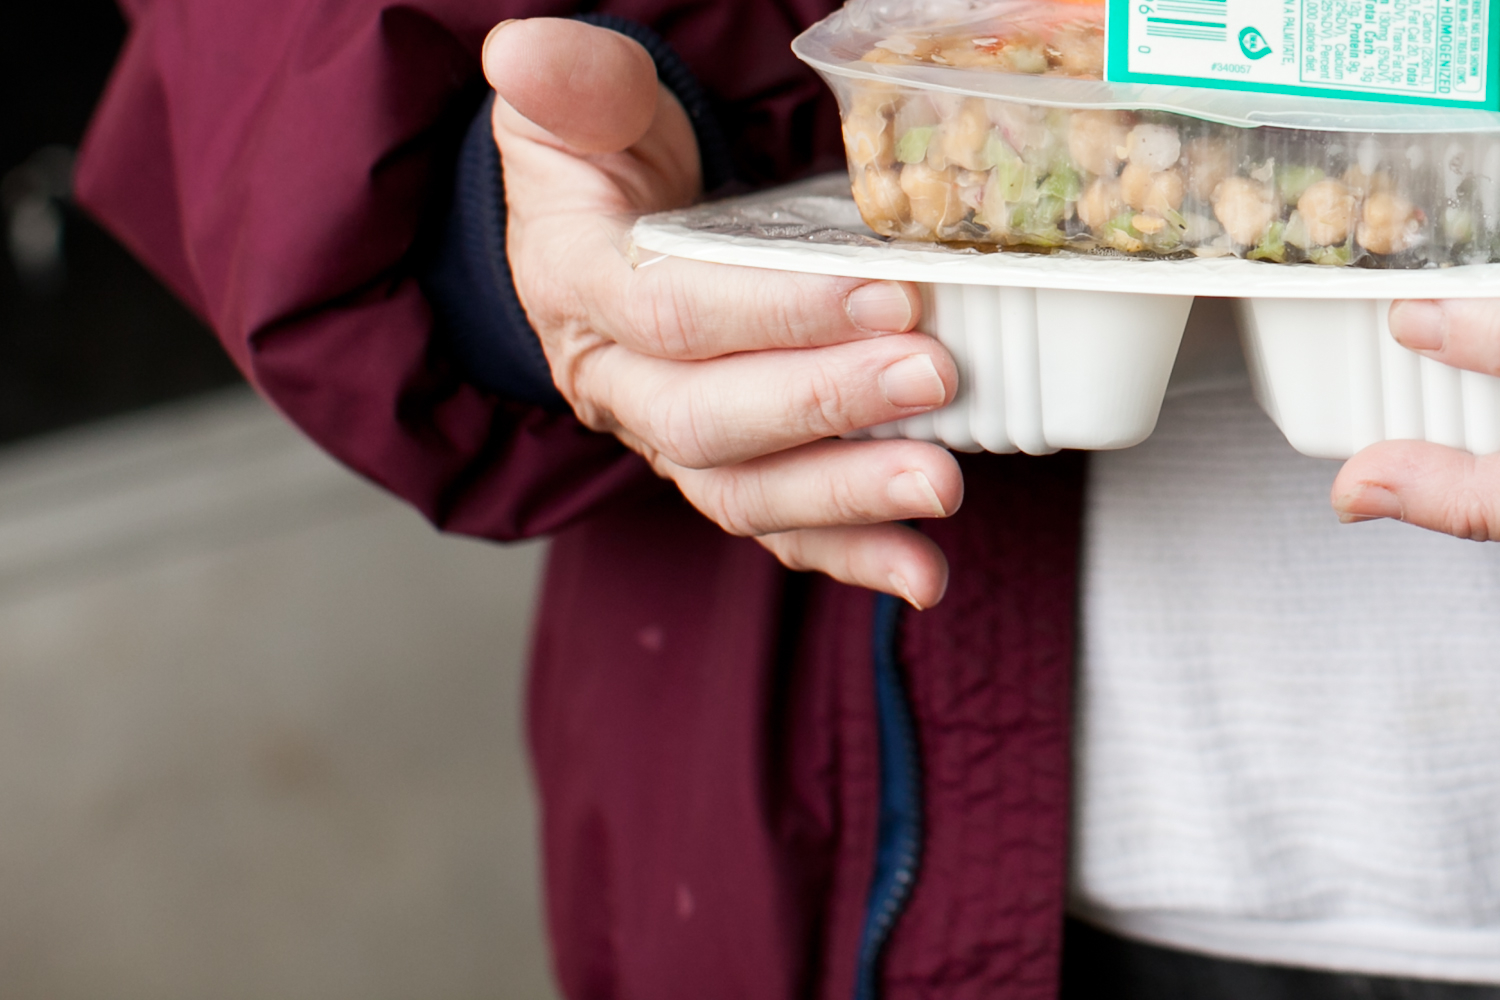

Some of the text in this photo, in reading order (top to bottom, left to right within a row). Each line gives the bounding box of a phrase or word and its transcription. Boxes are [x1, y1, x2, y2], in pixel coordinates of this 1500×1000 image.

[1347, 0, 1362, 18] 12g,
[1408, 9, 1420, 25] Fat
[1306, 22, 1318, 52] calorie
[1375, 10, 1390, 41] 130mg
[1407, 26, 1419, 43] Cal
[1422, 12, 1435, 44] Carton
[1137, 45, 1150, 54] 0
[1280, 15, 1294, 66] PALMITATE,
[1349, 22, 1361, 58] Protein
[1363, 30, 1375, 59] Carb.
[1403, 44, 1418, 58] 20,
[1437, 5, 1453, 94] HOMOGENIZED
[1211, 62, 1250, 73] #340057
[1305, 54, 1317, 73] diet.
[1318, 44, 1331, 79] Percent
[1345, 60, 1360, 74] 9g.
[1359, 66, 1374, 82] 13g
[1373, 45, 1389, 83] (5%DV),
[1405, 62, 1418, 86] Total
[1417, 46, 1434, 85] (236mL).
